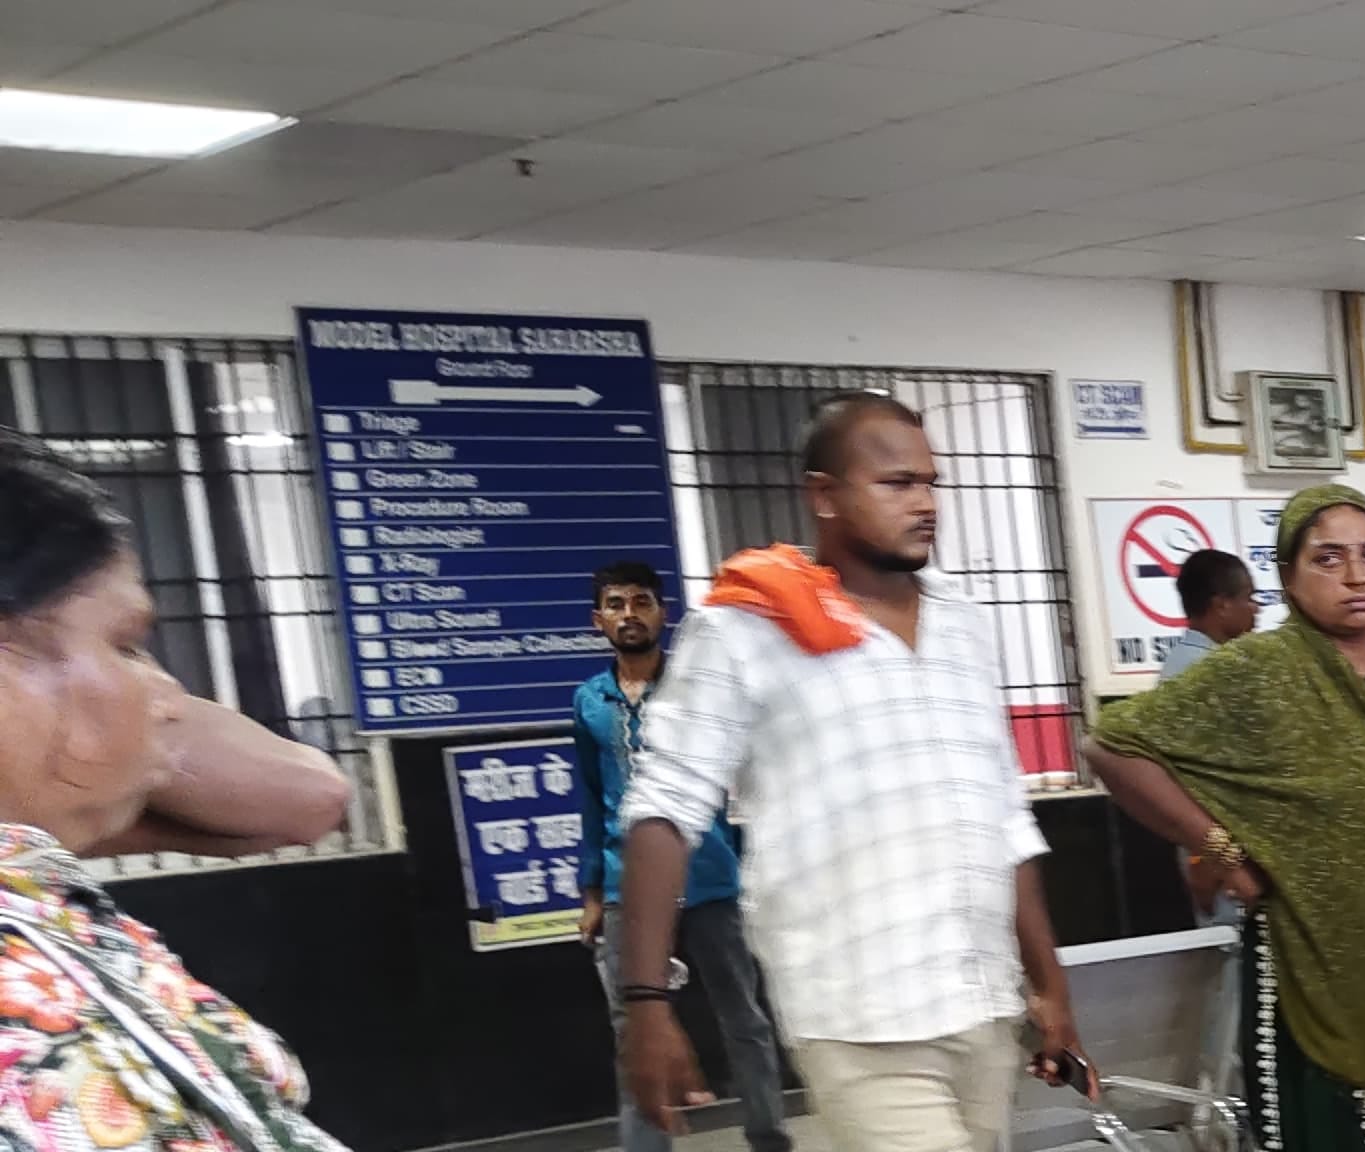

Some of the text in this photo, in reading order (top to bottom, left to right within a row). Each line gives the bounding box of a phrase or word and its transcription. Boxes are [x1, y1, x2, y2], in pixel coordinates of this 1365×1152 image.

[308, 320, 400, 350] MODEL
[397, 323, 516, 353] HOSPITAL
[356, 410, 421, 436] Triage
[408, 440, 456, 460] Stair
[366, 469, 479, 488] Green Zone
[369, 497, 530, 517] Procedure Room
[373, 525, 486, 549] Radiologist
[379, 551, 440, 578] X-Ray
[381, 582, 467, 602] CT Scan
[450, 636, 522, 658] Sample
[1115, 637, 1144, 665] NO
[537, 753, 574, 796] के
